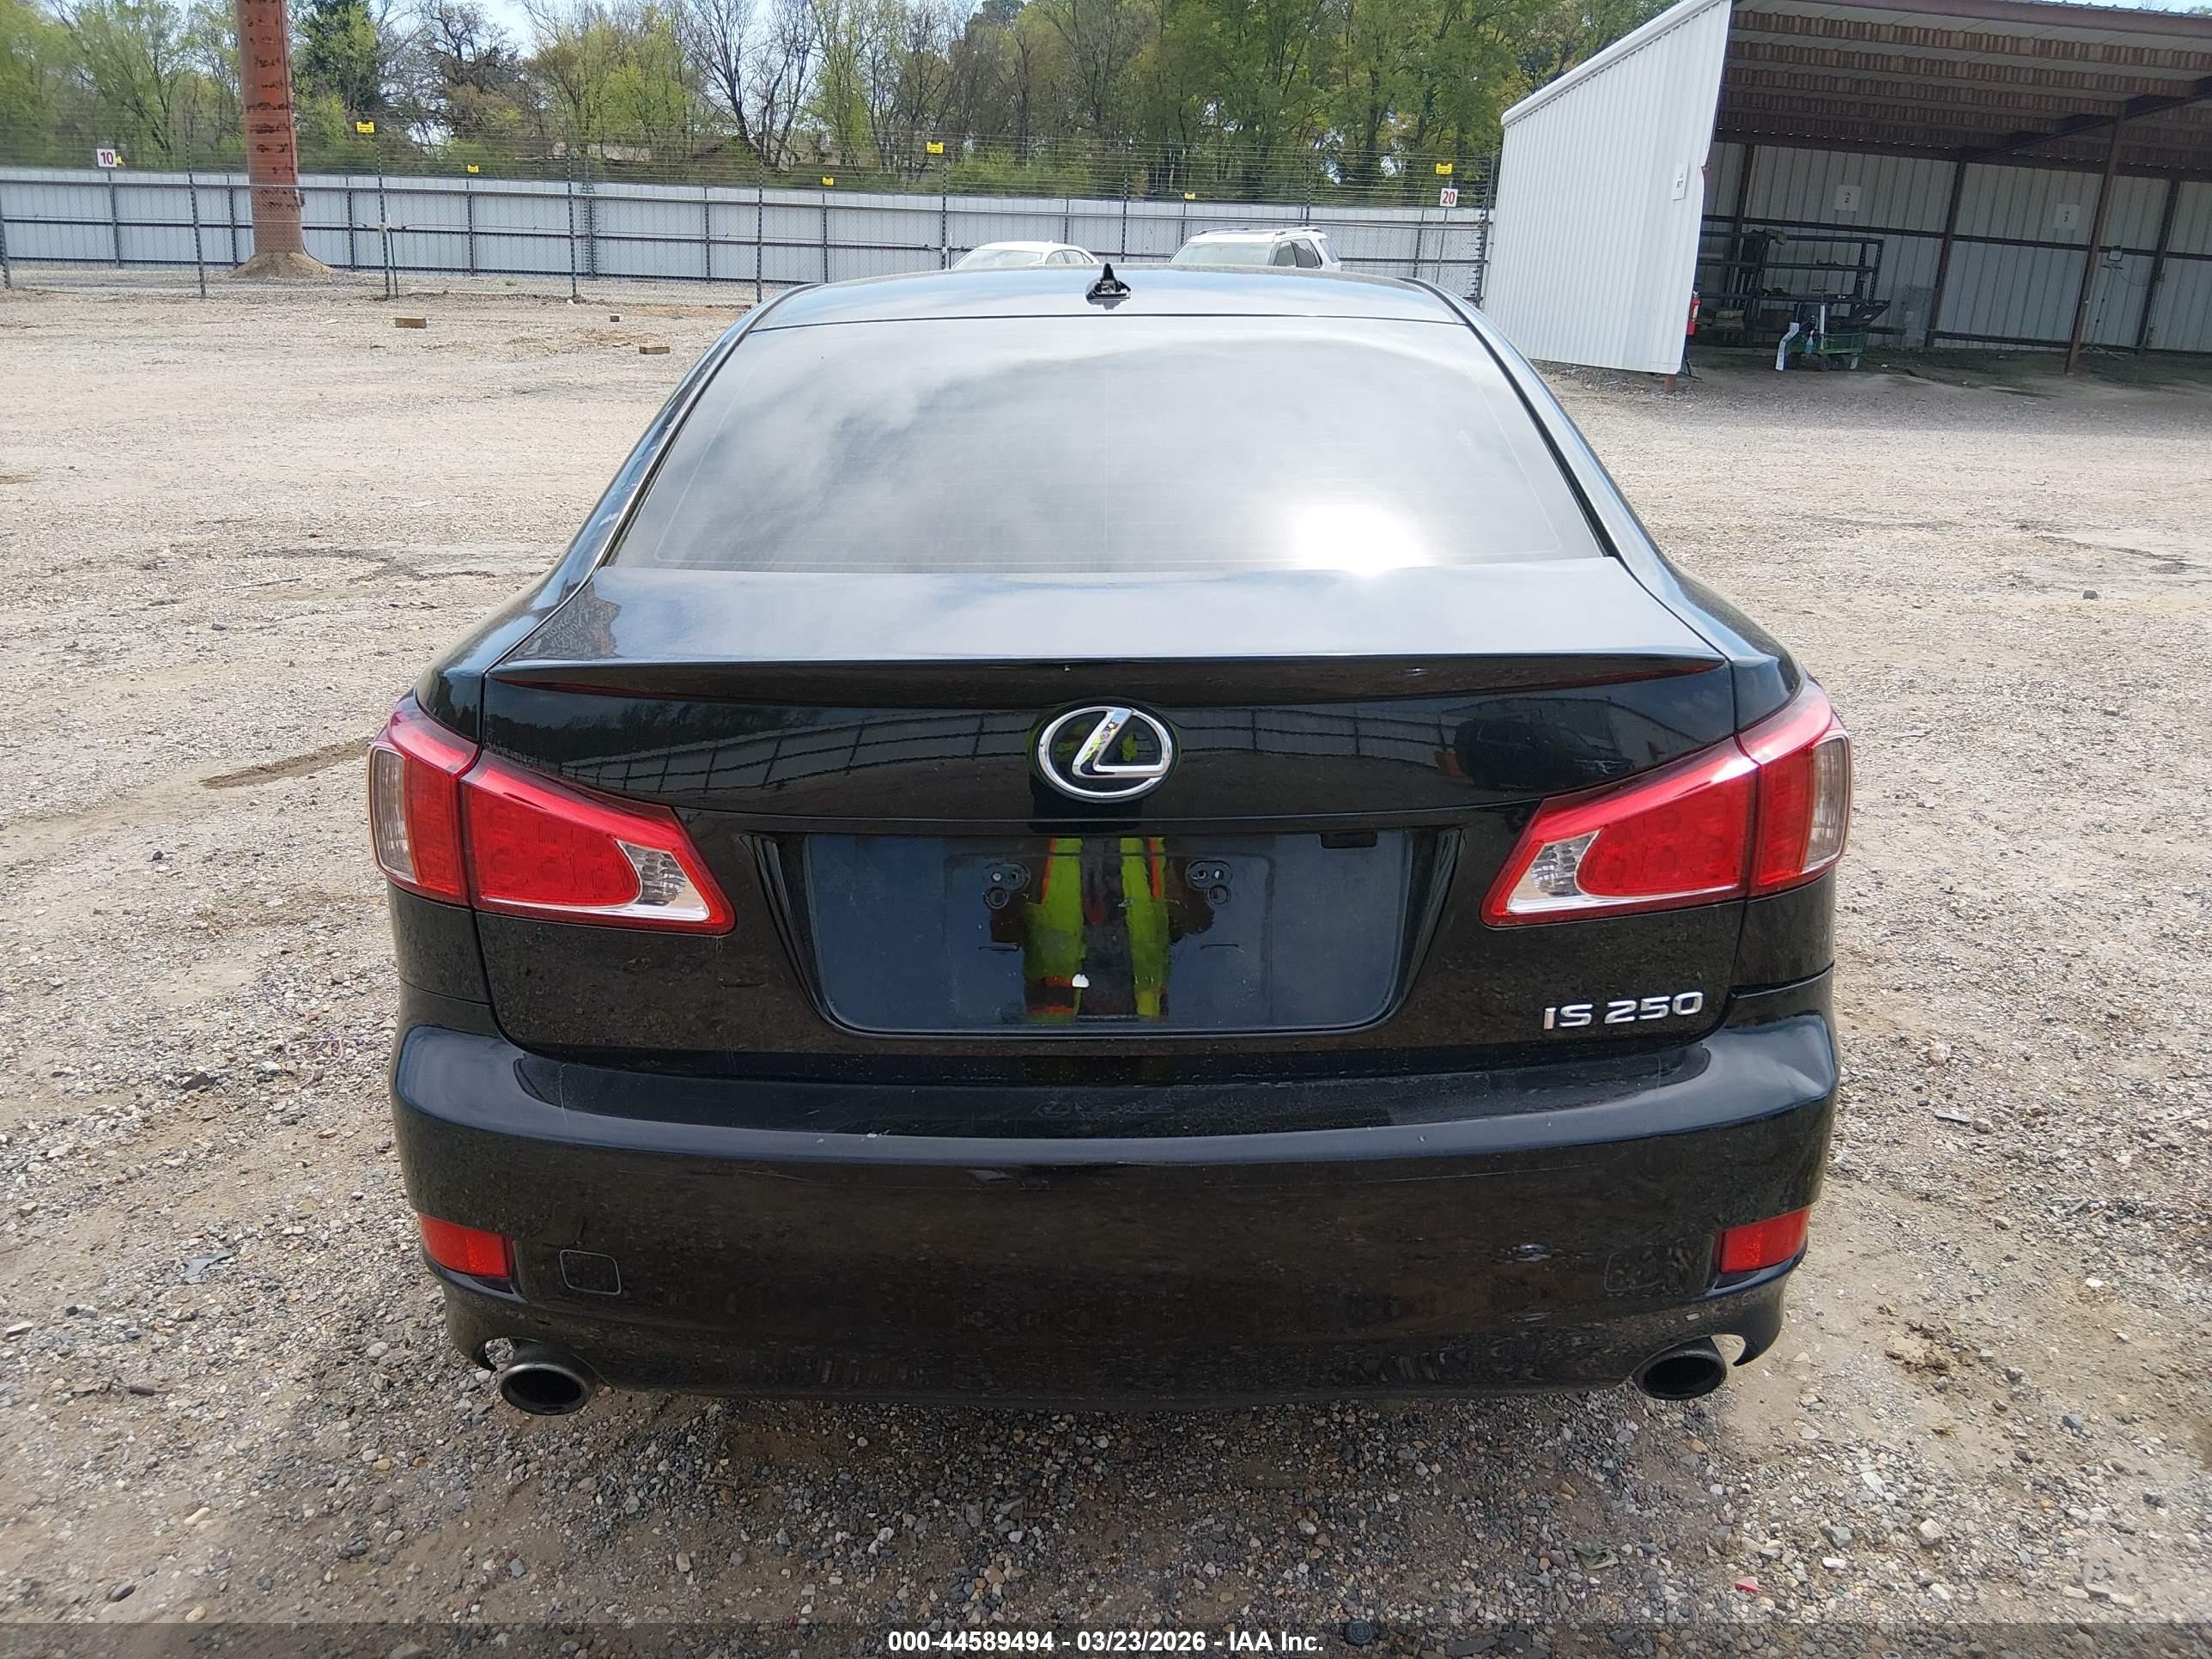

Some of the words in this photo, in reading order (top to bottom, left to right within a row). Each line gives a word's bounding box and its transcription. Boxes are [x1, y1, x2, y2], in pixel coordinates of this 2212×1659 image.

[100, 151, 113, 165] 10
[1443, 191, 1455, 204] 20
[1543, 1004, 1594, 1030] IS
[1604, 991, 1704, 1024] 250
